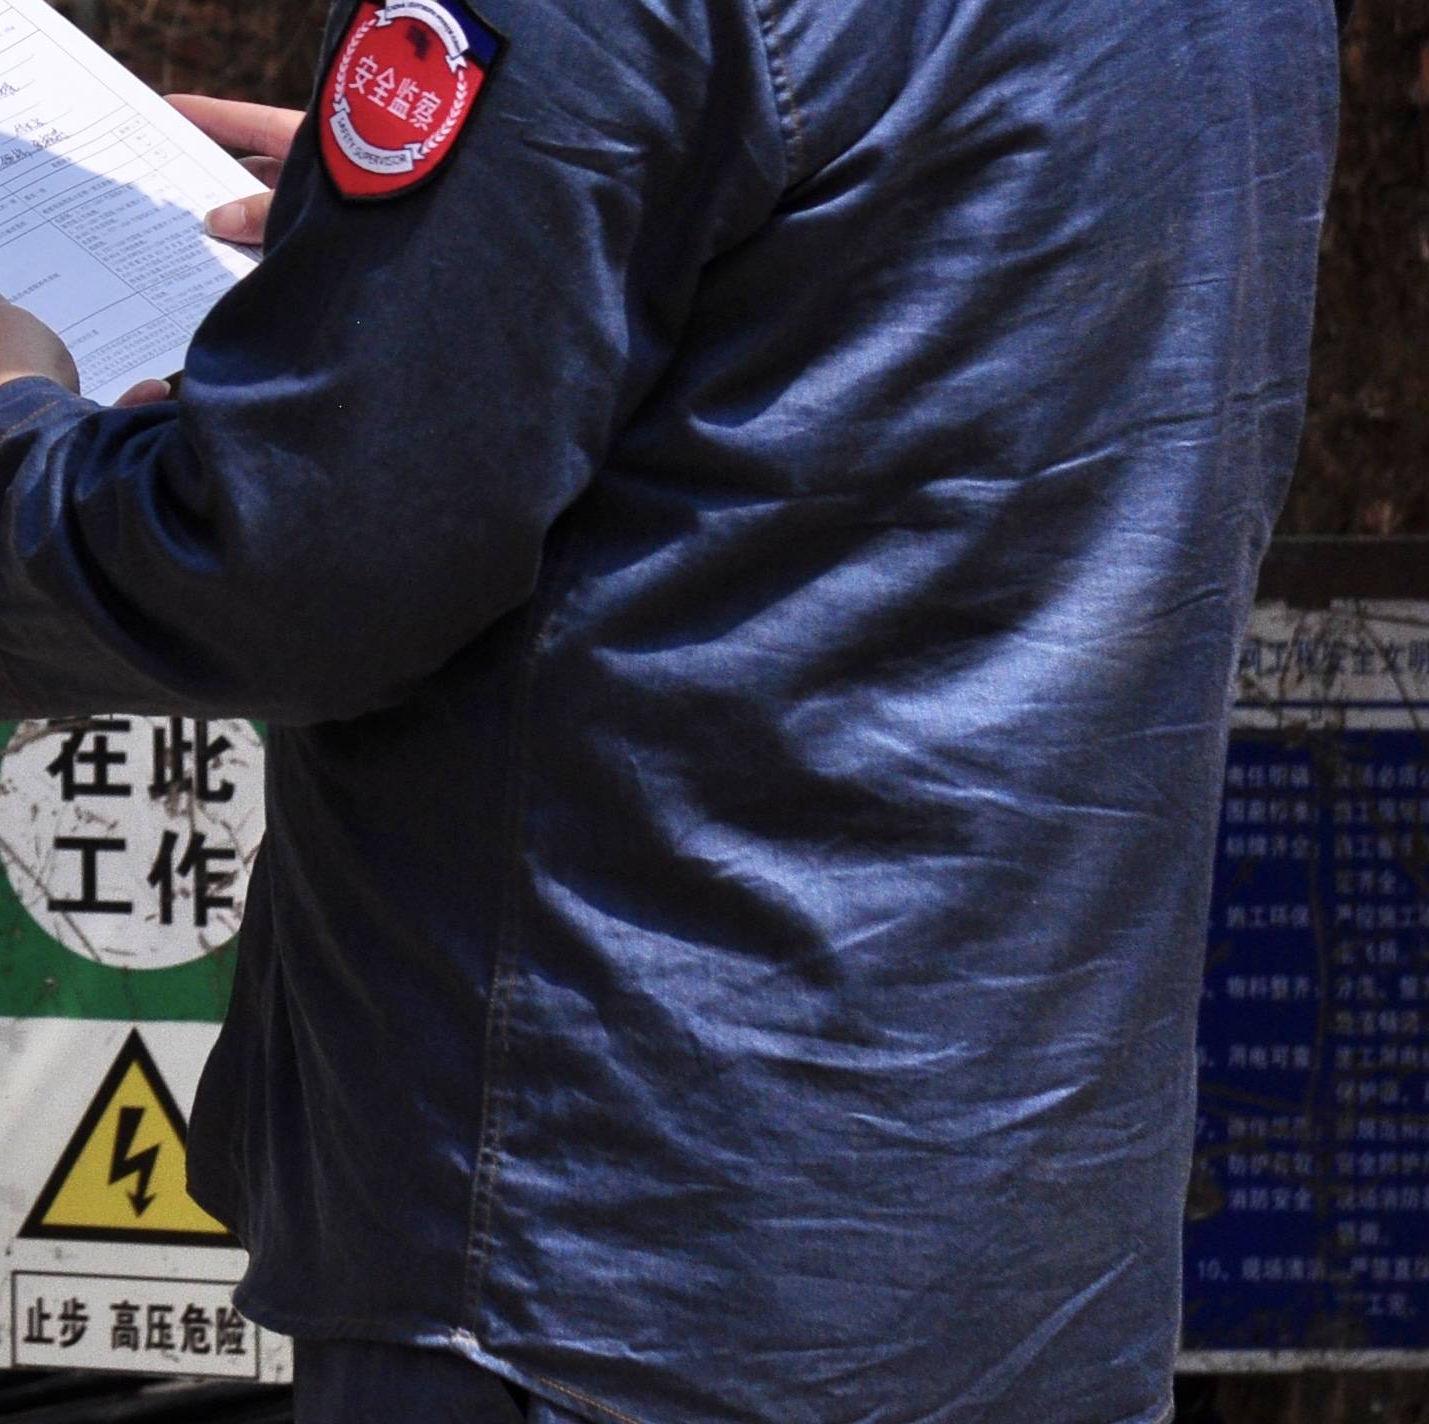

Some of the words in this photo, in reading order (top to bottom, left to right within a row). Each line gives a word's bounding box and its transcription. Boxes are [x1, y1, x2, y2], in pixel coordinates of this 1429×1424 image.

[349, 56, 442, 132] 安全监察
[46, 716, 236, 801] 在此
[47, 832, 238, 928] 工作
[23, 1296, 91, 1349] 止步
[109, 1299, 249, 1360] 高压危险
